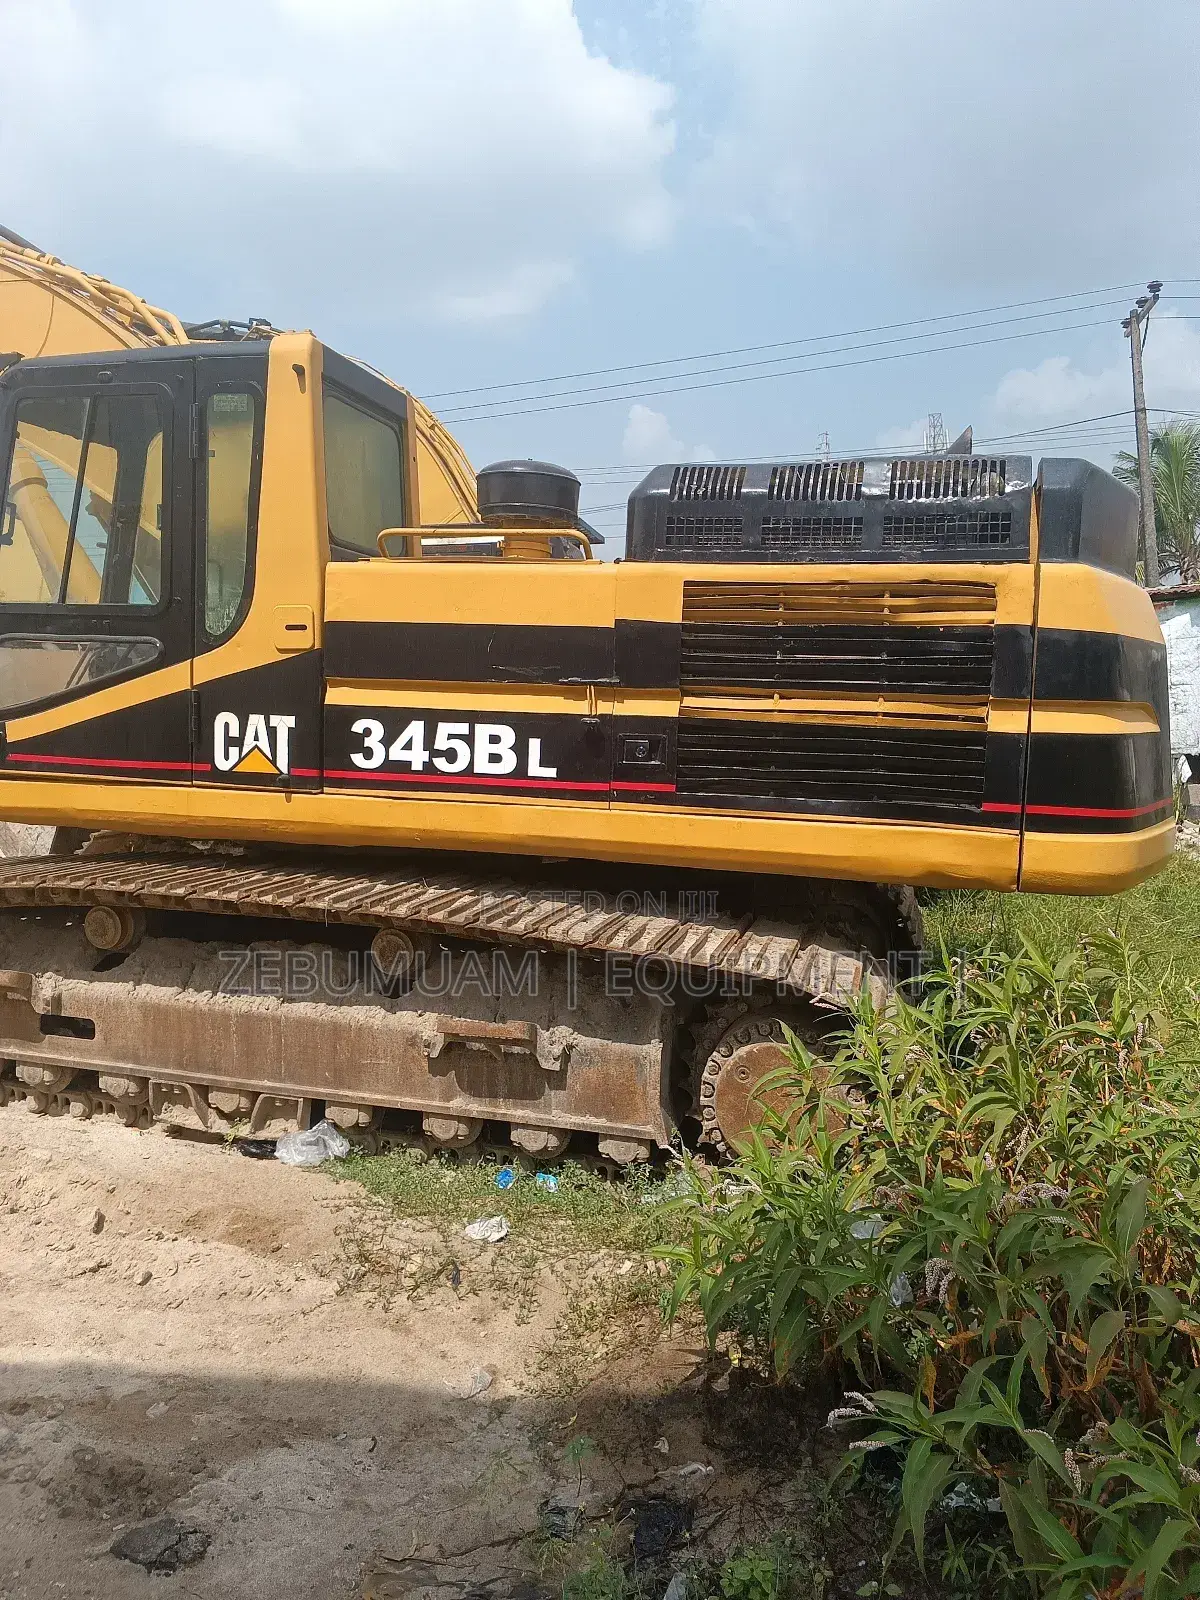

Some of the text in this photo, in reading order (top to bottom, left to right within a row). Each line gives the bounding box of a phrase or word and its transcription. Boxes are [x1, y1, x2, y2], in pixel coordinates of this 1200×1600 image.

[214, 711, 296, 775] CAT
[349, 718, 558, 778] 345B L
